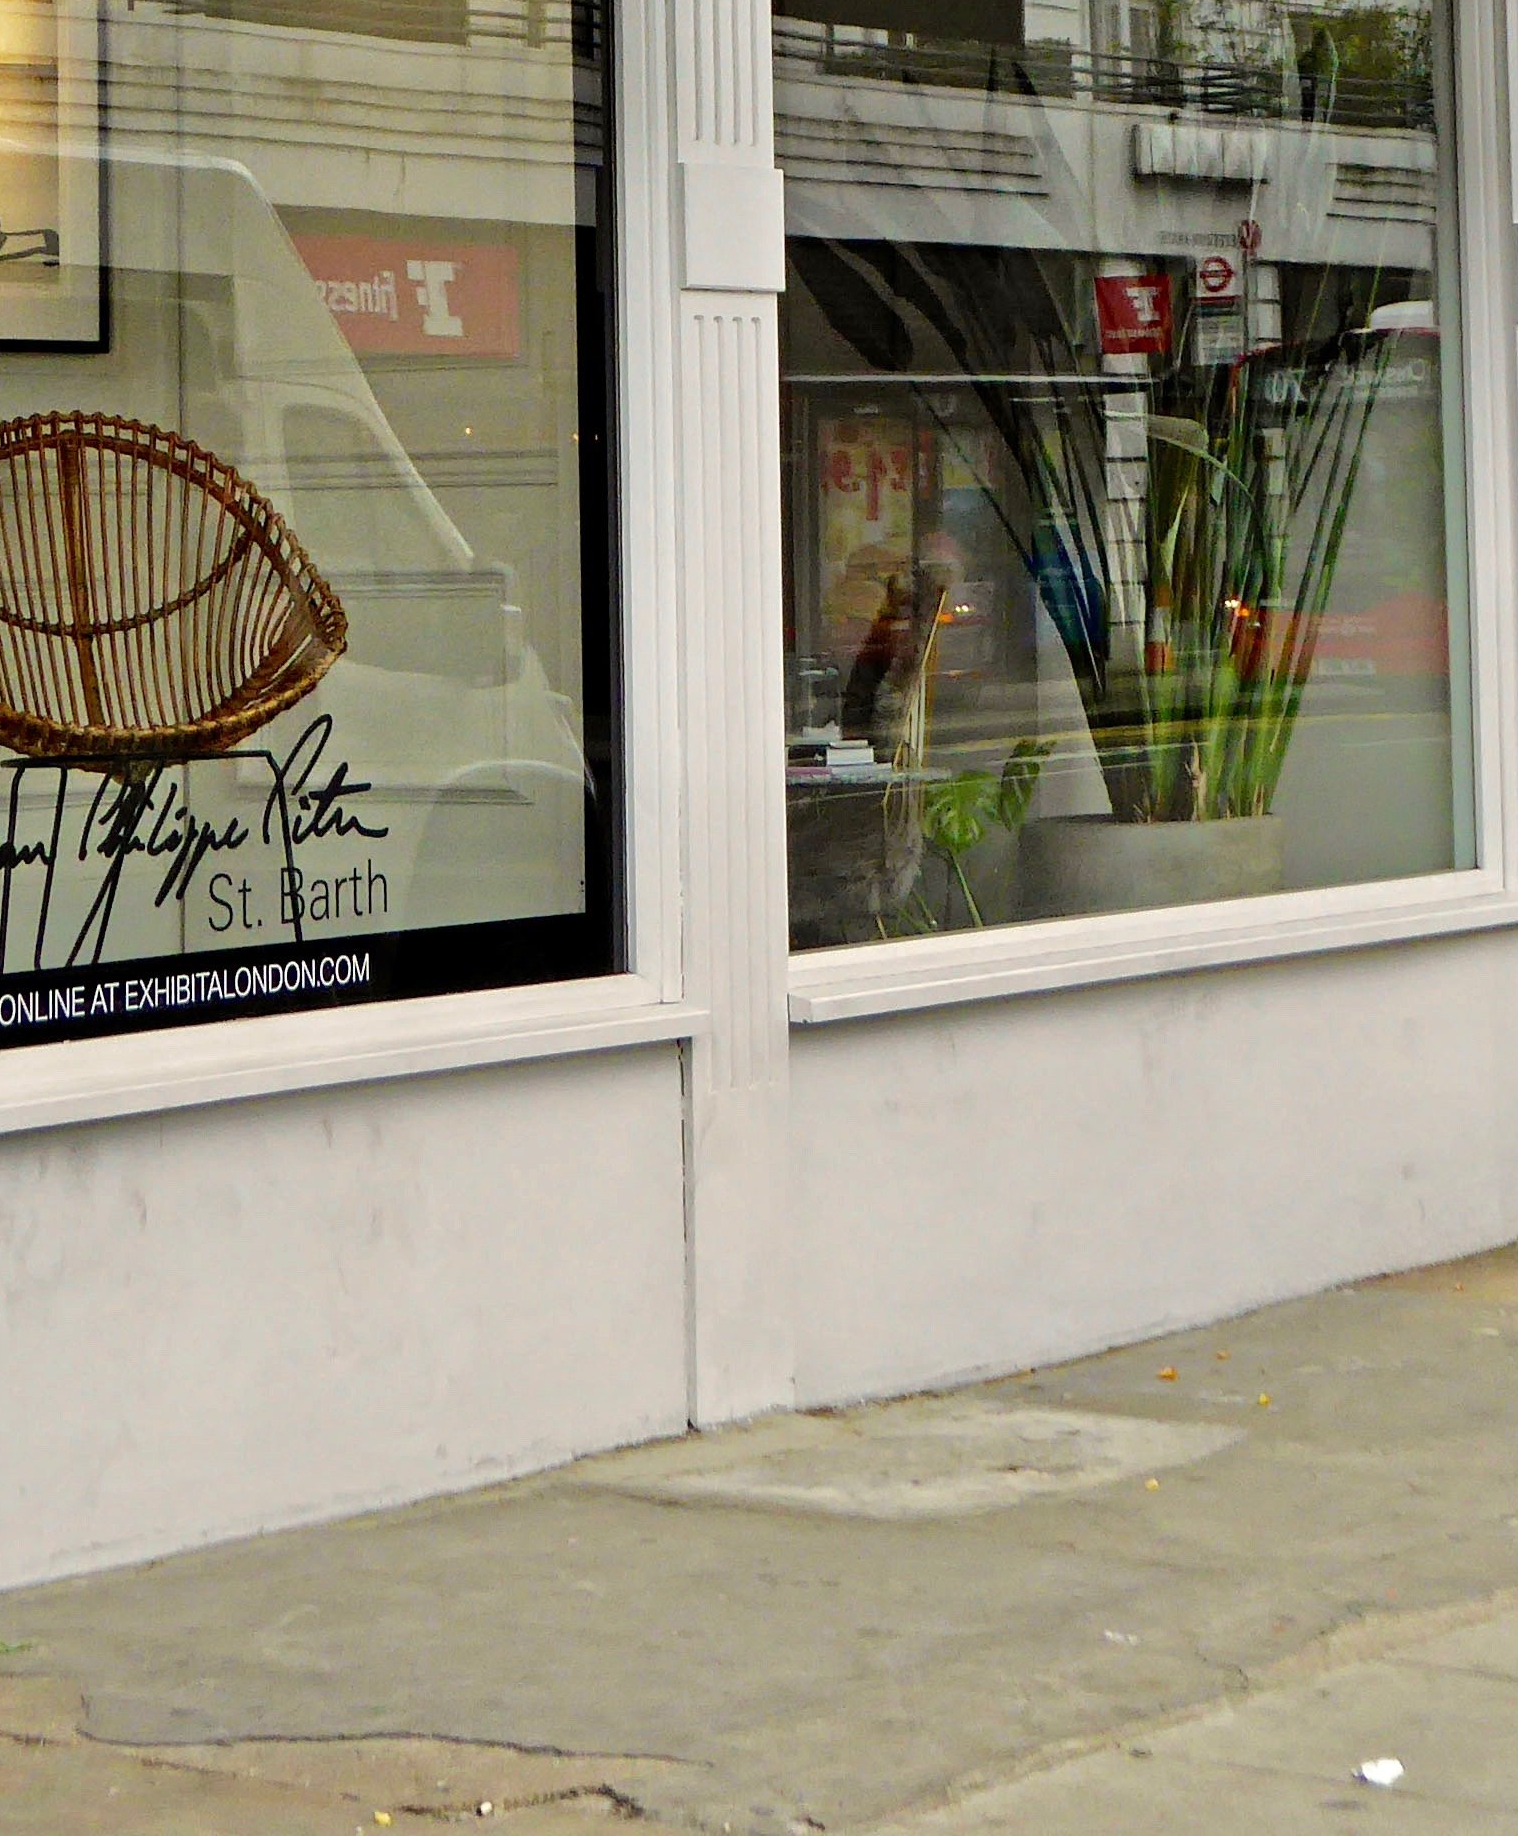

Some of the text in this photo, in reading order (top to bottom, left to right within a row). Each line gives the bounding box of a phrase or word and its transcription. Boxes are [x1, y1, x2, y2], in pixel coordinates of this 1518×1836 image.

[208, 859, 389, 932] St. Barth
[90, 982, 120, 1014] AT
[124, 952, 370, 1012] EXHIBITALONDON.COM
